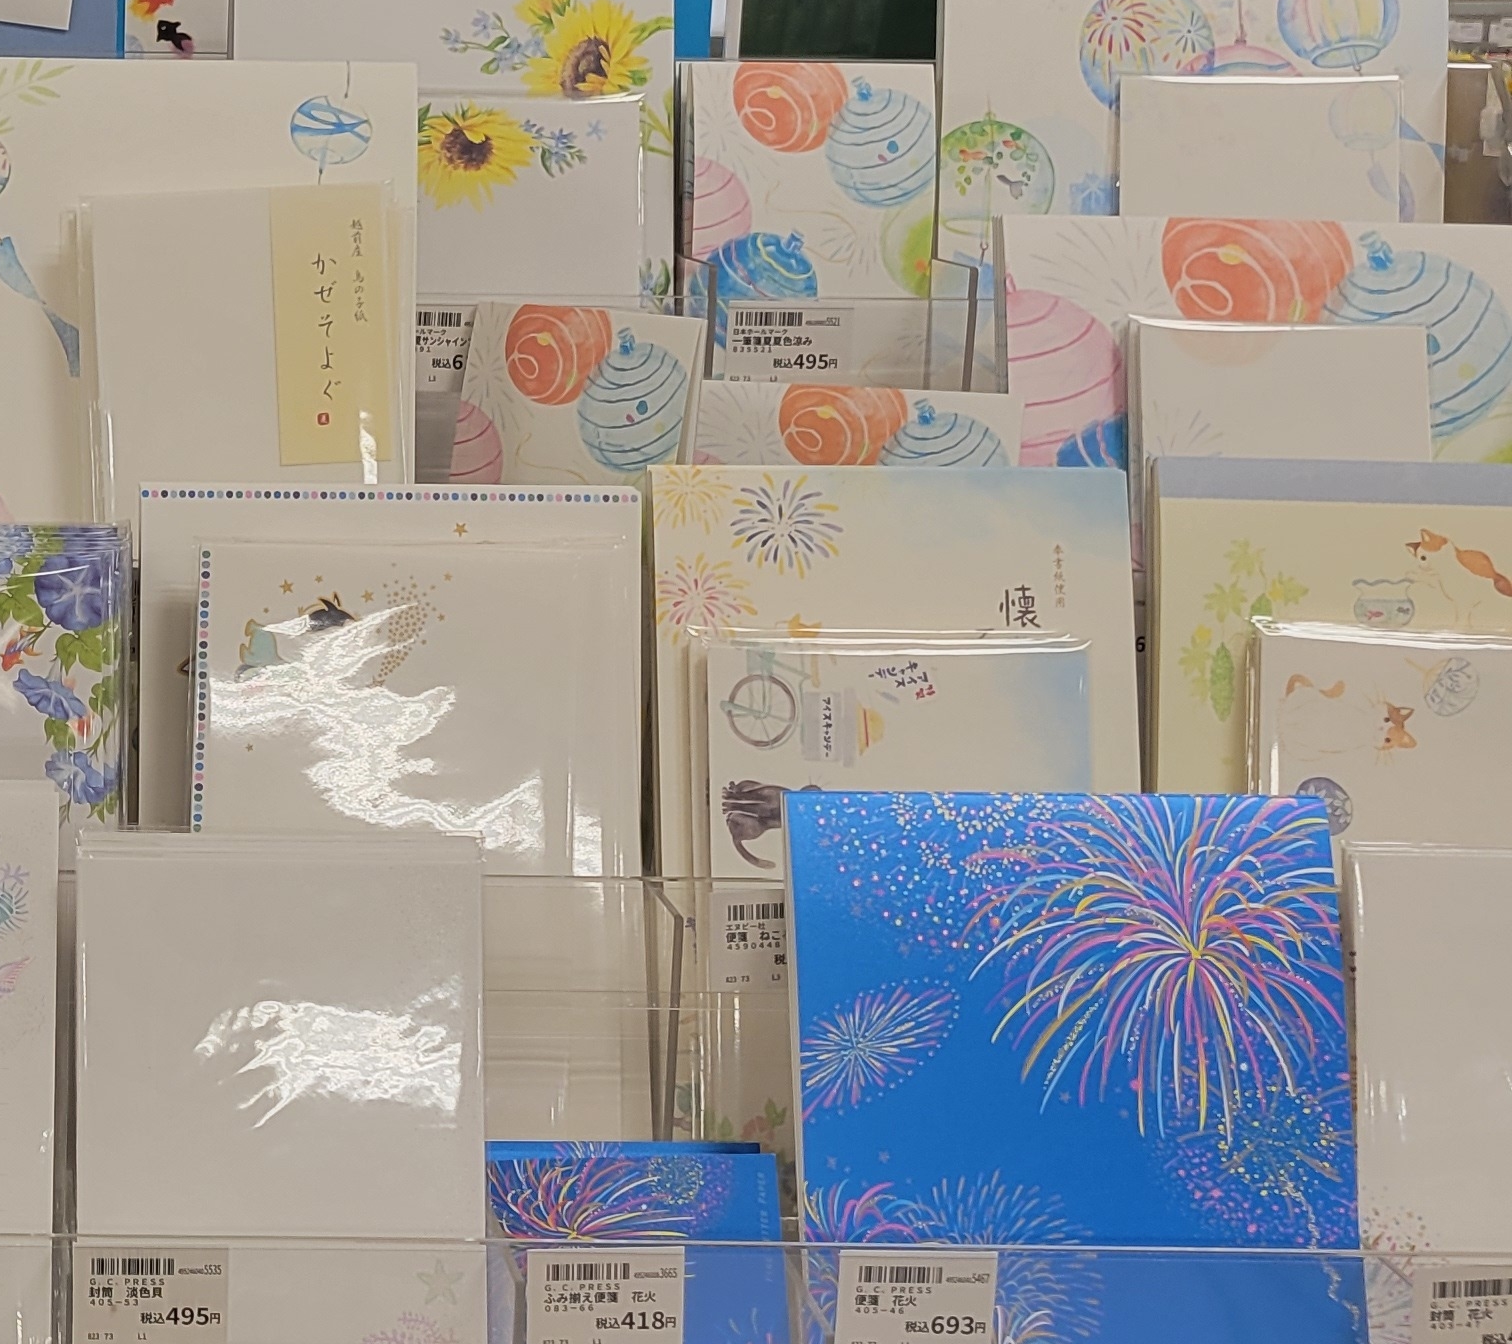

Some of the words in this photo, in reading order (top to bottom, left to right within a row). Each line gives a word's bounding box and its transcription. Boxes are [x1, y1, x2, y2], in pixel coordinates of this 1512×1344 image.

[312, 252, 342, 401] かぜそよぐ
[773, 354, 839, 370] 税込495円
[999, 584, 1042, 629] 懐
[125, 1286, 164, 1299] 淡色貝
[631, 1290, 657, 1303] 花火
[892, 1294, 917, 1307] 花火
[140, 1306, 221, 1326] 税込495円
[595, 1310, 677, 1330] 税込418円
[904, 1315, 986, 1335] 税込693円
